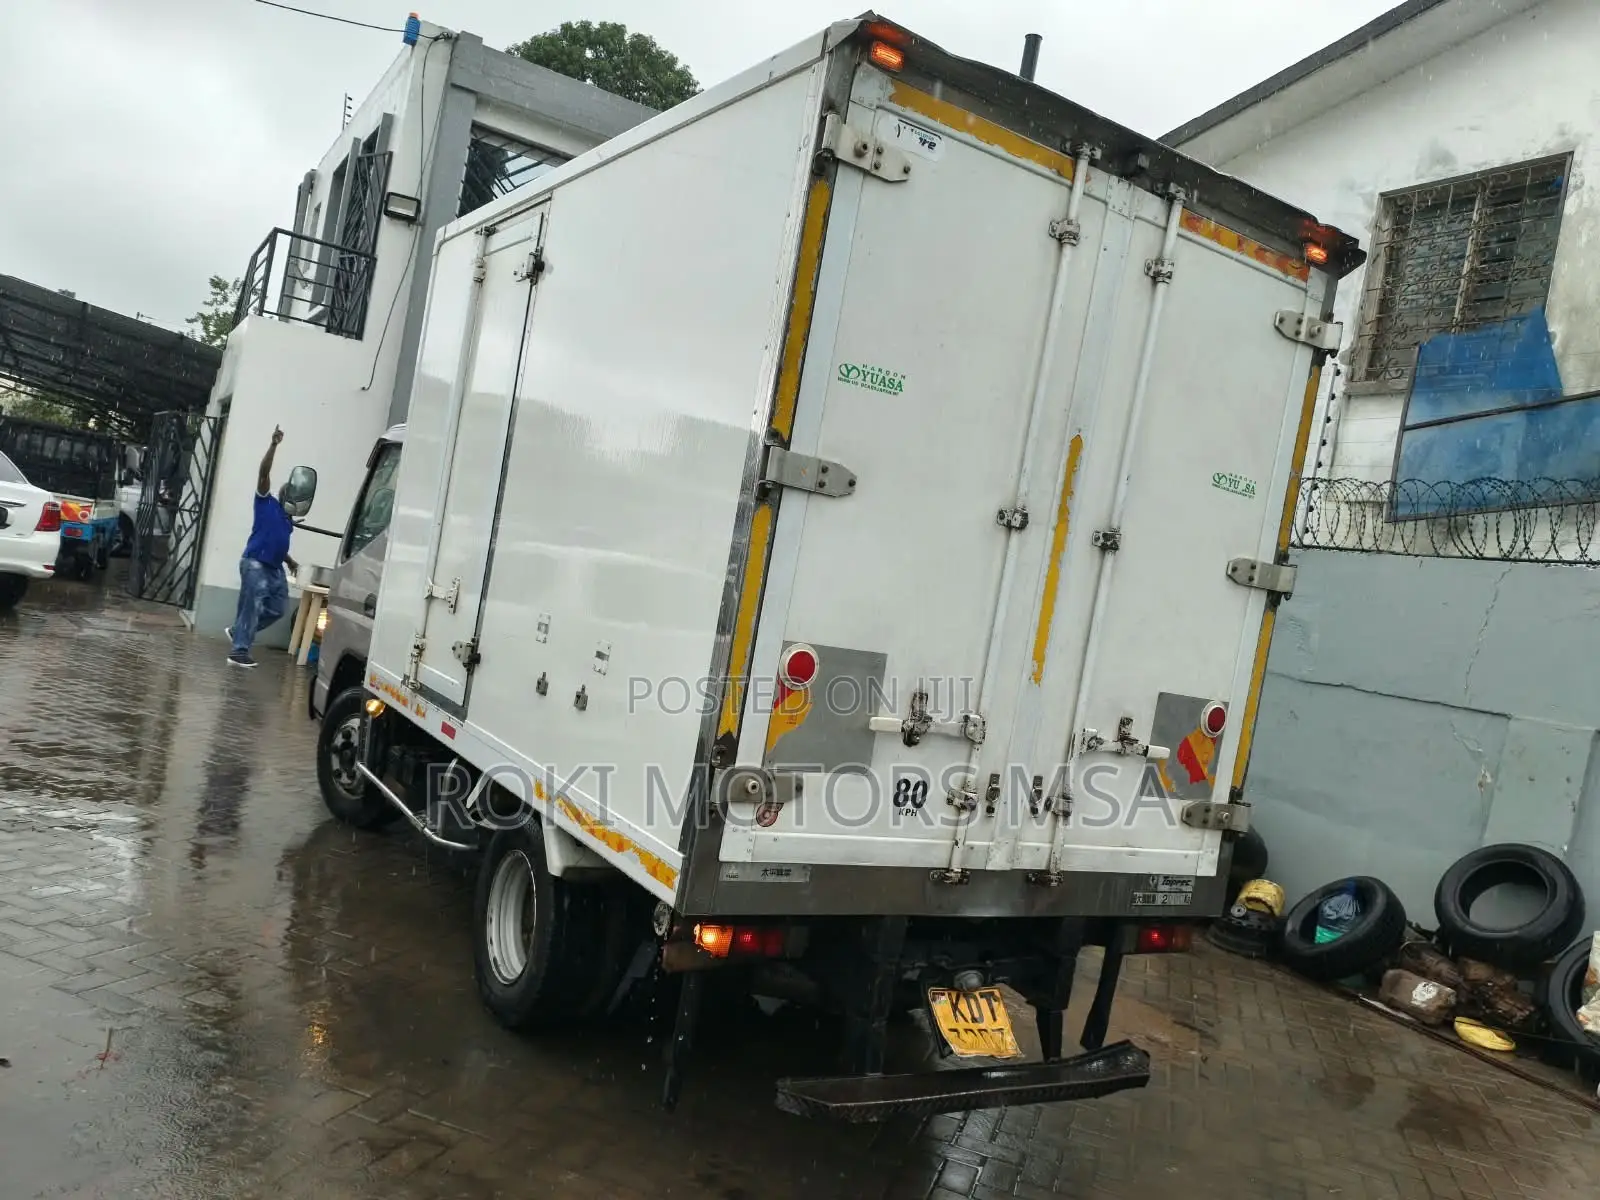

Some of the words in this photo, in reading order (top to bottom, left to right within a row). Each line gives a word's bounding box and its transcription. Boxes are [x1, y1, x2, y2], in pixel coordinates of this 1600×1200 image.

[861, 370, 903, 392] YUASA
[1228, 477, 1256, 495] YUSA
[893, 778, 928, 809] 80
[898, 808, 918, 817] KPH
